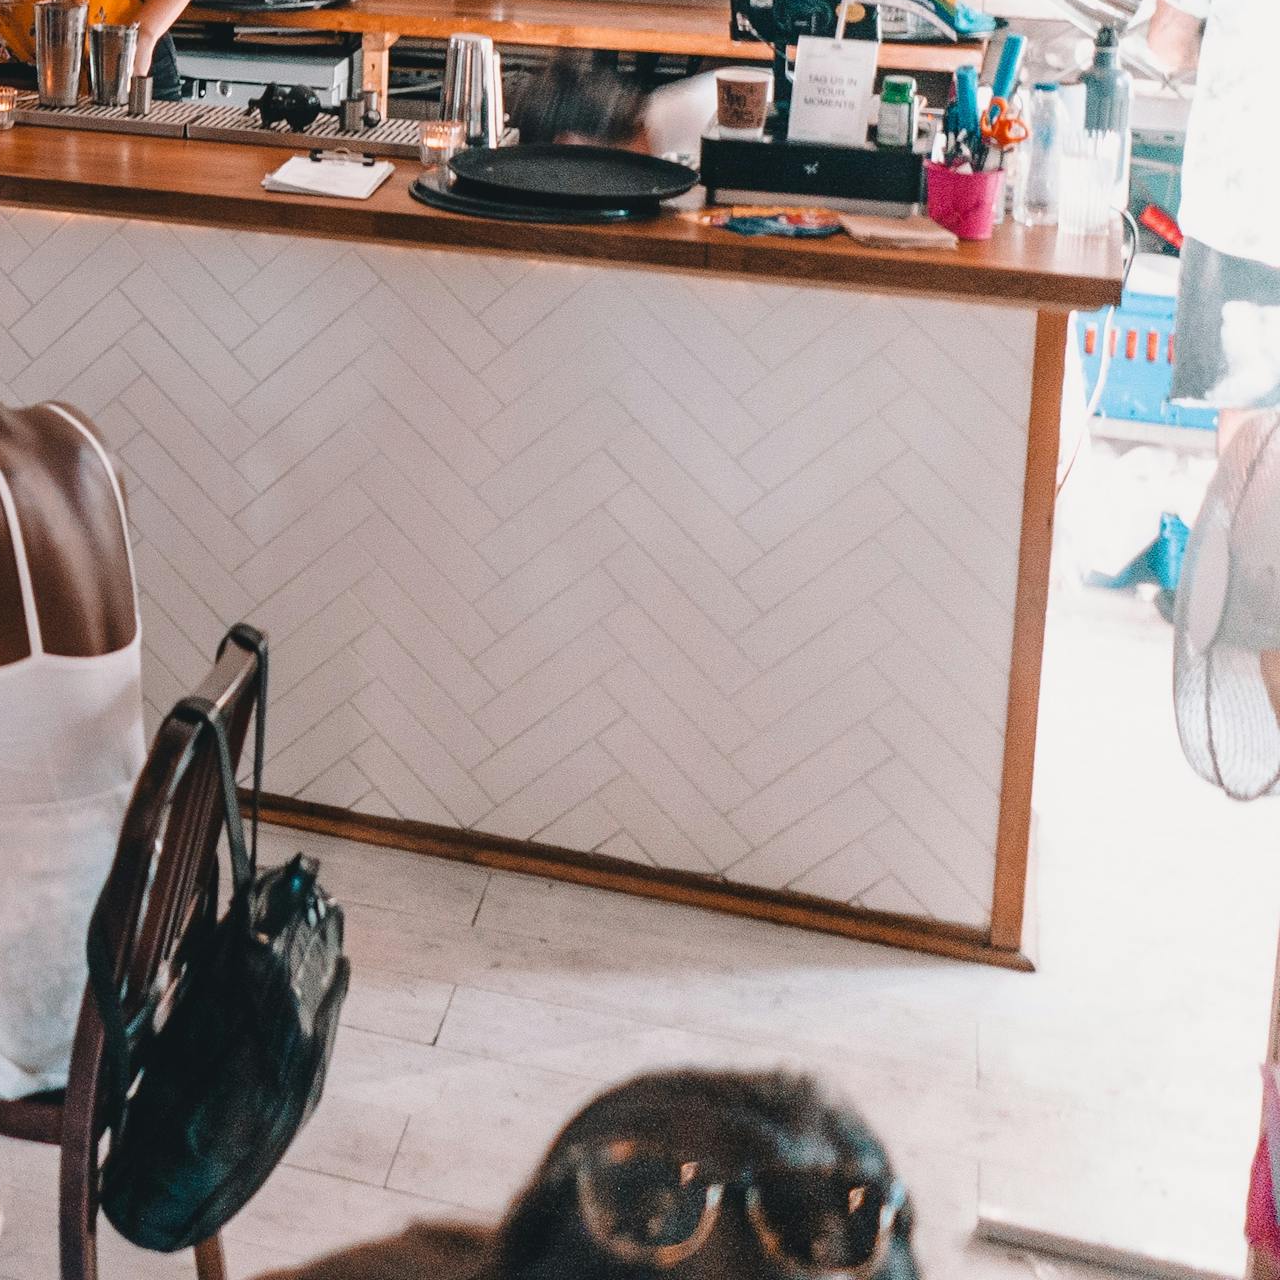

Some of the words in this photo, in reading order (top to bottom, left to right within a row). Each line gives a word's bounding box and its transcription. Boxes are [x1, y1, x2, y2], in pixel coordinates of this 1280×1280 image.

[807, 73, 828, 84] TAG
[829, 74, 844, 85] US
[846, 77, 858, 87] IN
[816, 85, 845, 96] YOUR
[802, 97, 856, 110] MOMENTS
